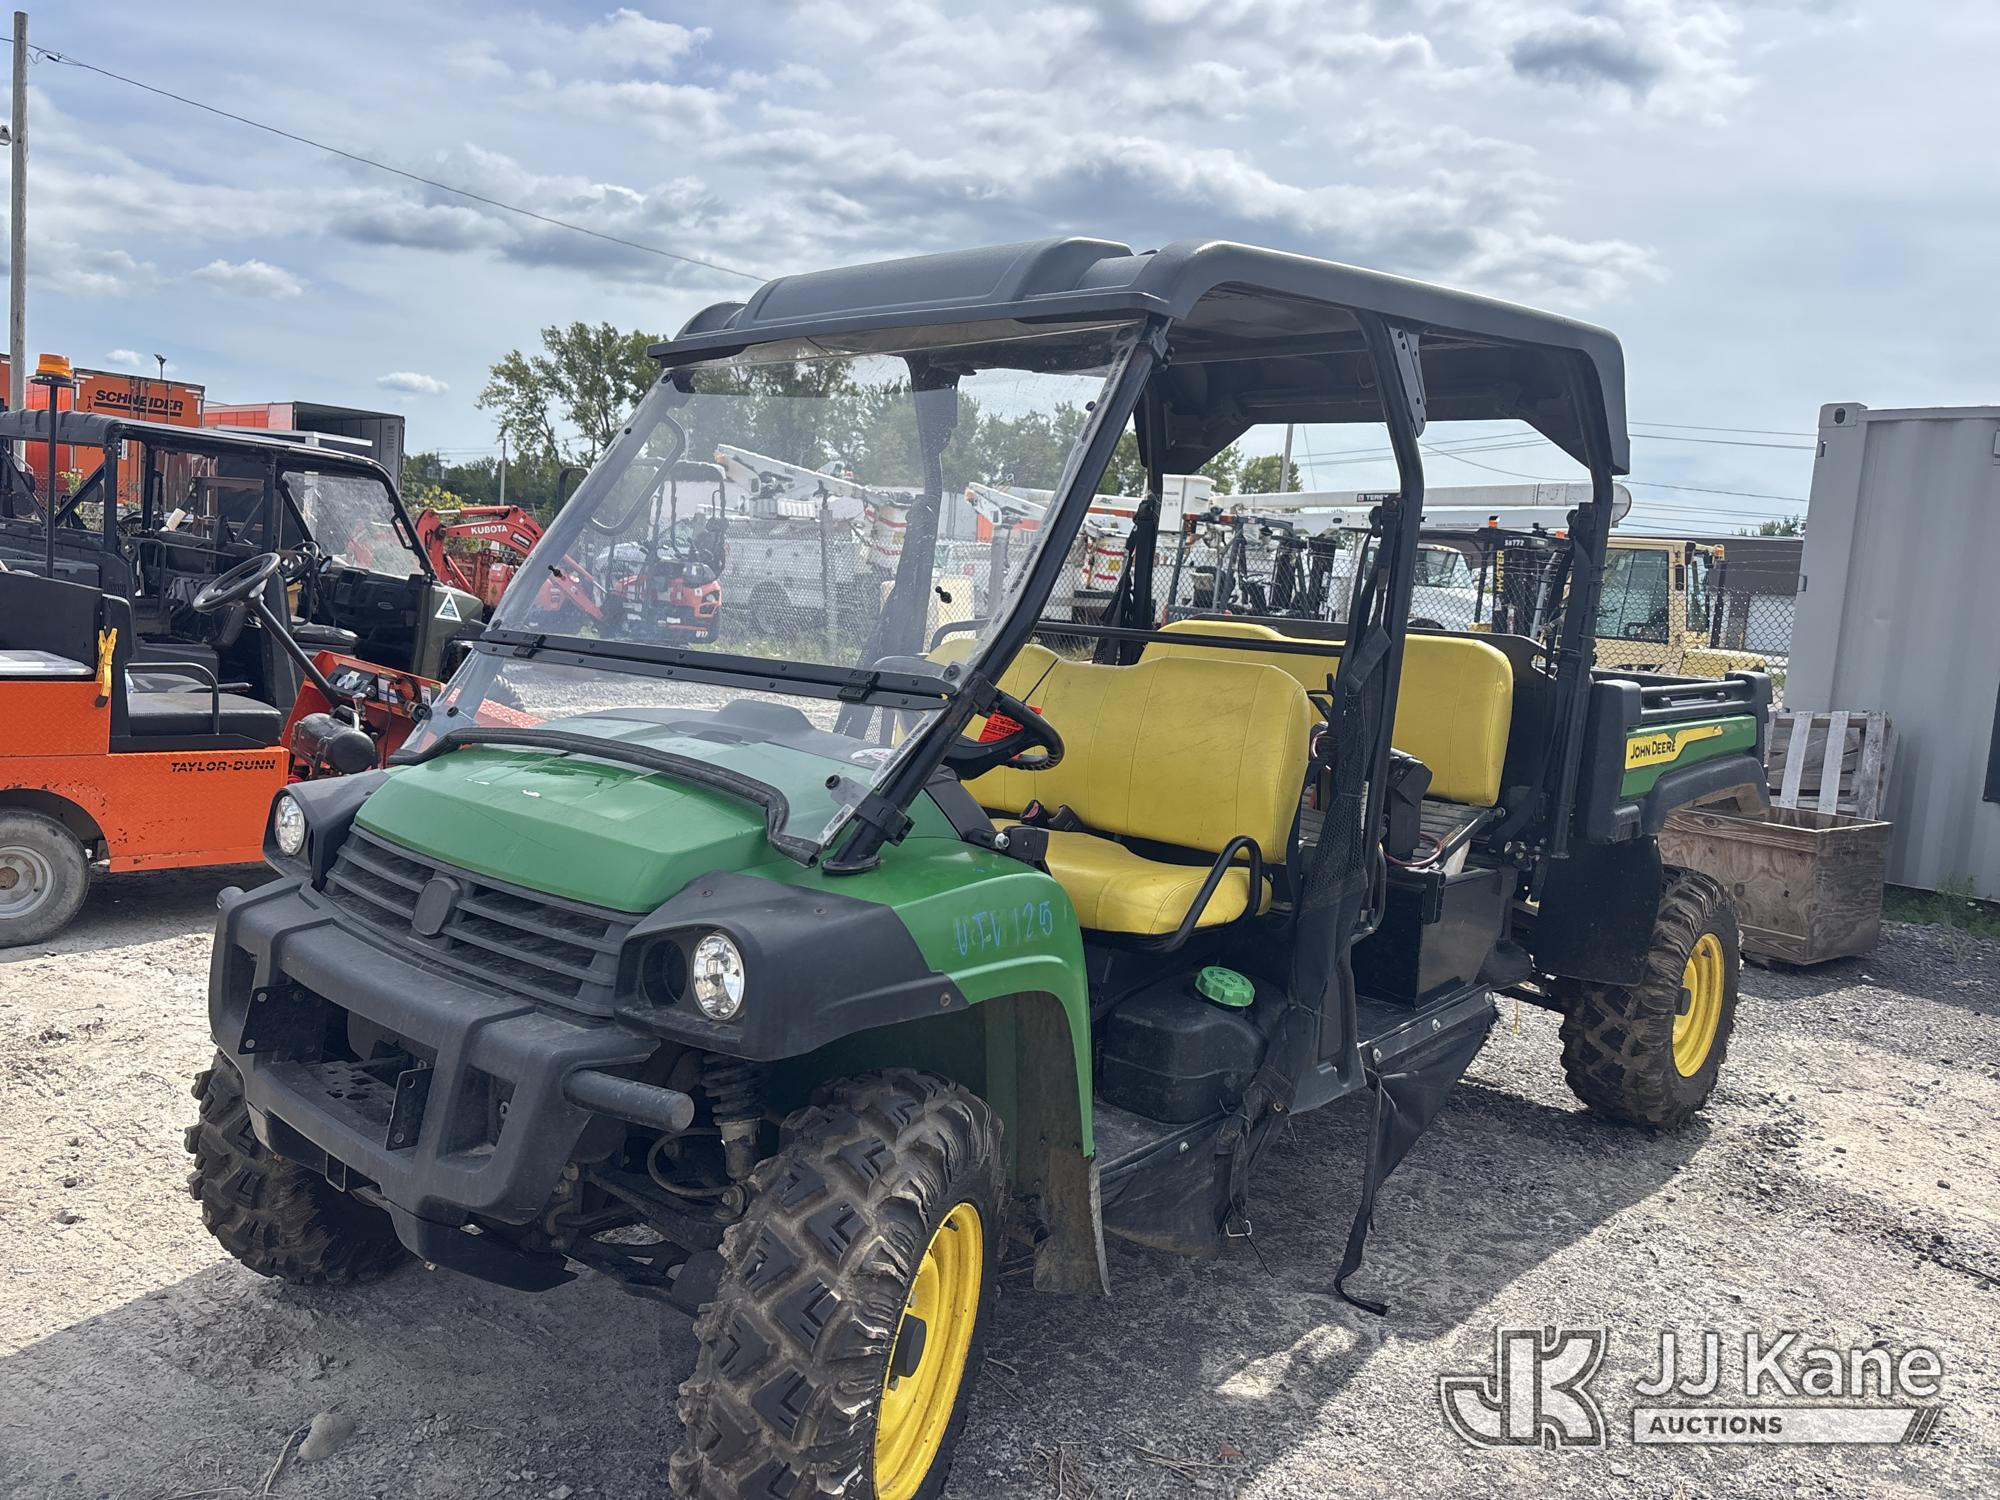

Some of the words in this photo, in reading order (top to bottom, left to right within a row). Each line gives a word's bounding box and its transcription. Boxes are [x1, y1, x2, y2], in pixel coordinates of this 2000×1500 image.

[95, 390, 184, 411] SCHNEIDER
[471, 525, 508, 535] KUBOTA
[1496, 550, 1504, 593] HYSTER
[1630, 744, 1651, 759] JOHN
[1652, 741, 1676, 756] DEERE
[171, 760, 276, 773] TAYLOR-DUNN
